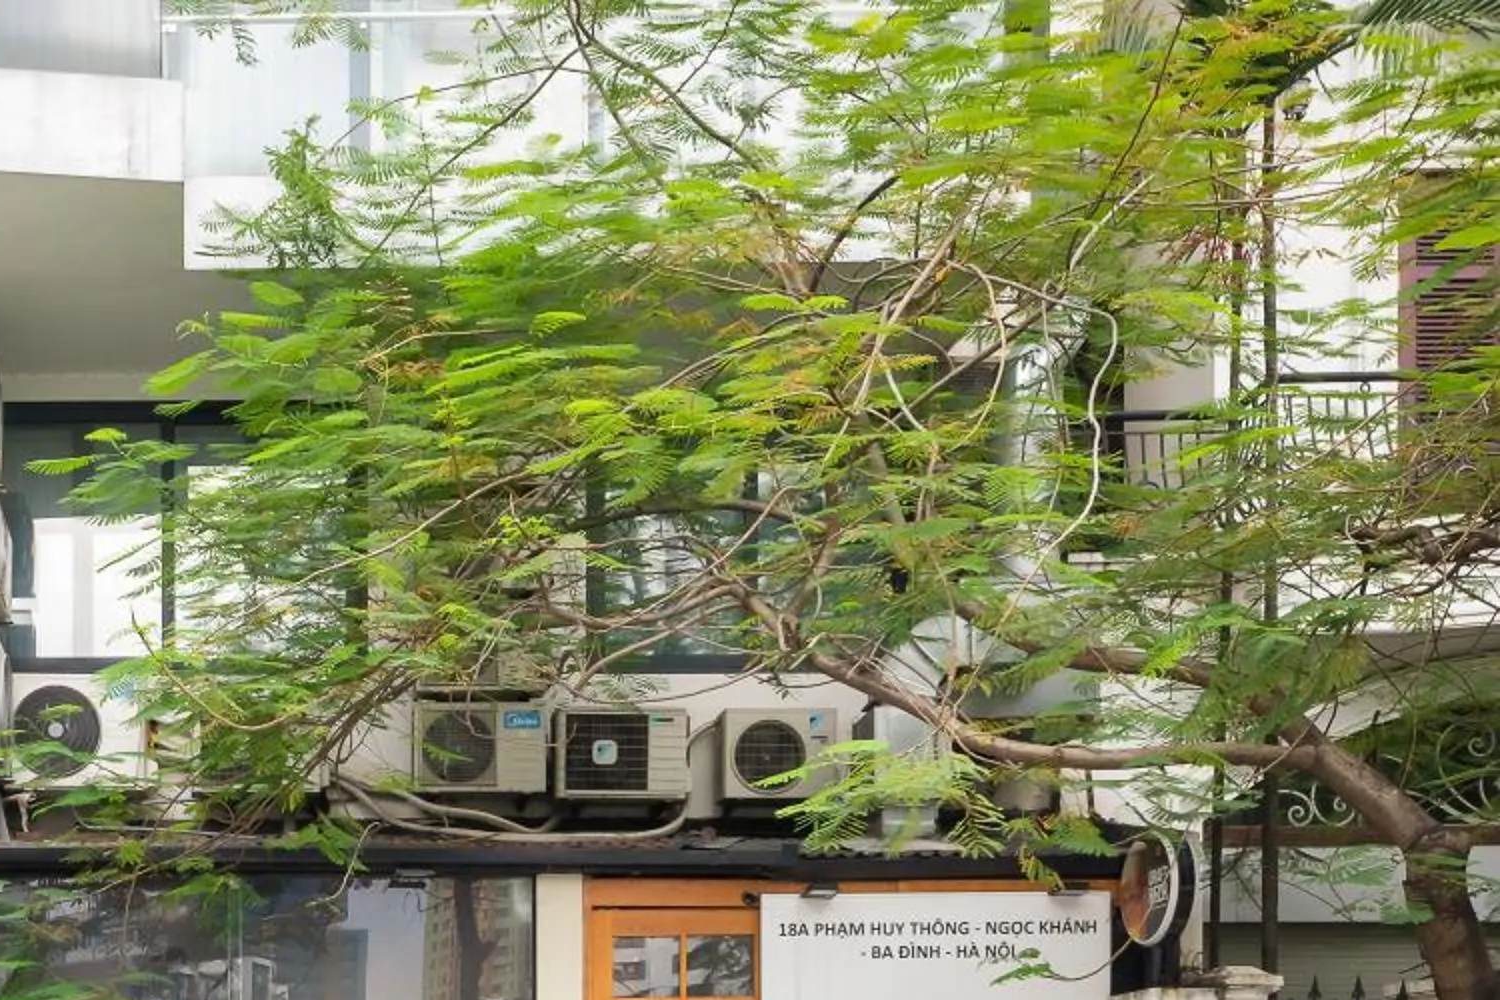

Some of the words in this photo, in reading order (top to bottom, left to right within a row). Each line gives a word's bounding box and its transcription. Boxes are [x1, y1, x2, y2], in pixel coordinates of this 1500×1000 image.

[779, 922, 809, 937] 18A
[815, 922, 865, 939] PHẠM
[870, 922, 904, 936] HUY
[910, 918, 969, 935] THÔNG
[986, 921, 1034, 938] NGỌC
[1040, 917, 1097, 934] KHÁNH
[871, 945, 894, 959] BA
[898, 941, 940, 959] ĐÌNH
[956, 942, 980, 959] HÀ
